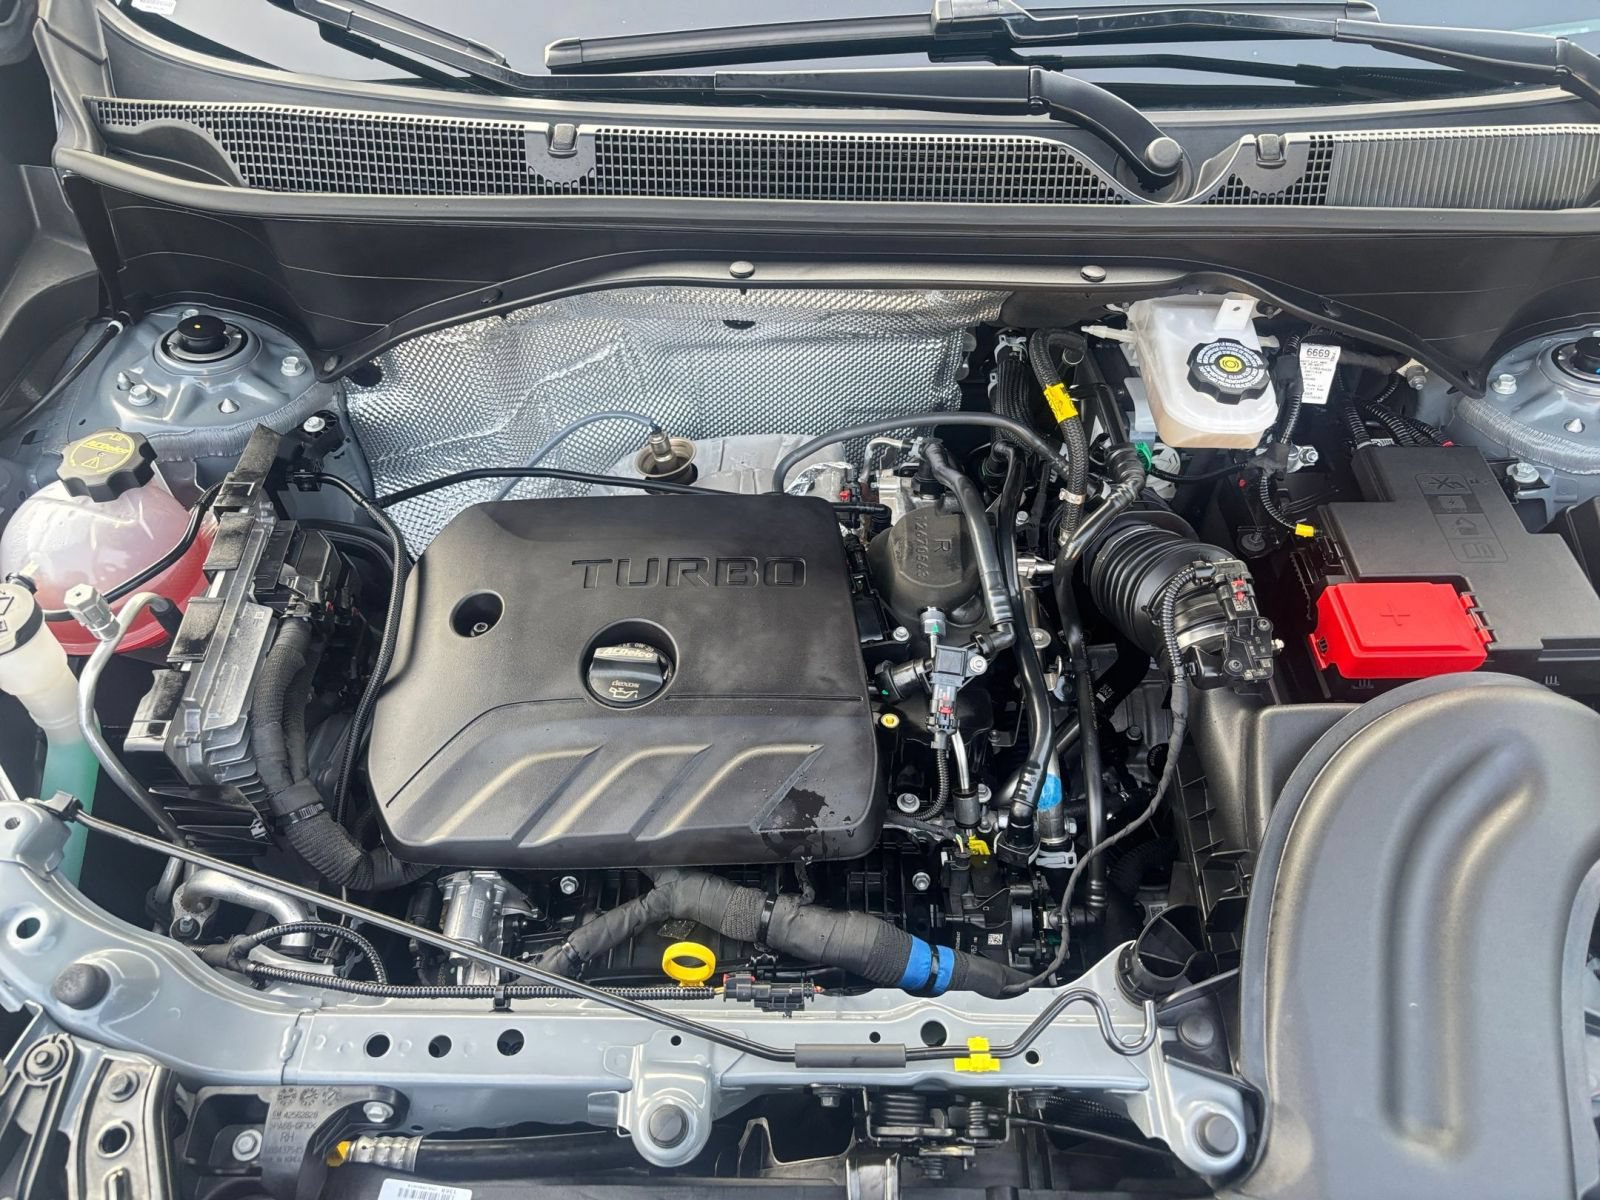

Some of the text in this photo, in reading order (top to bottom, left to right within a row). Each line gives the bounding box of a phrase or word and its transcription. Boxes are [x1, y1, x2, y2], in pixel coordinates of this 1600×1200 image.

[1306, 348, 1330, 358] 6669
[934, 538, 952, 553] R
[571, 556, 807, 589] TURBO
[280, 1132, 295, 1143] RH
